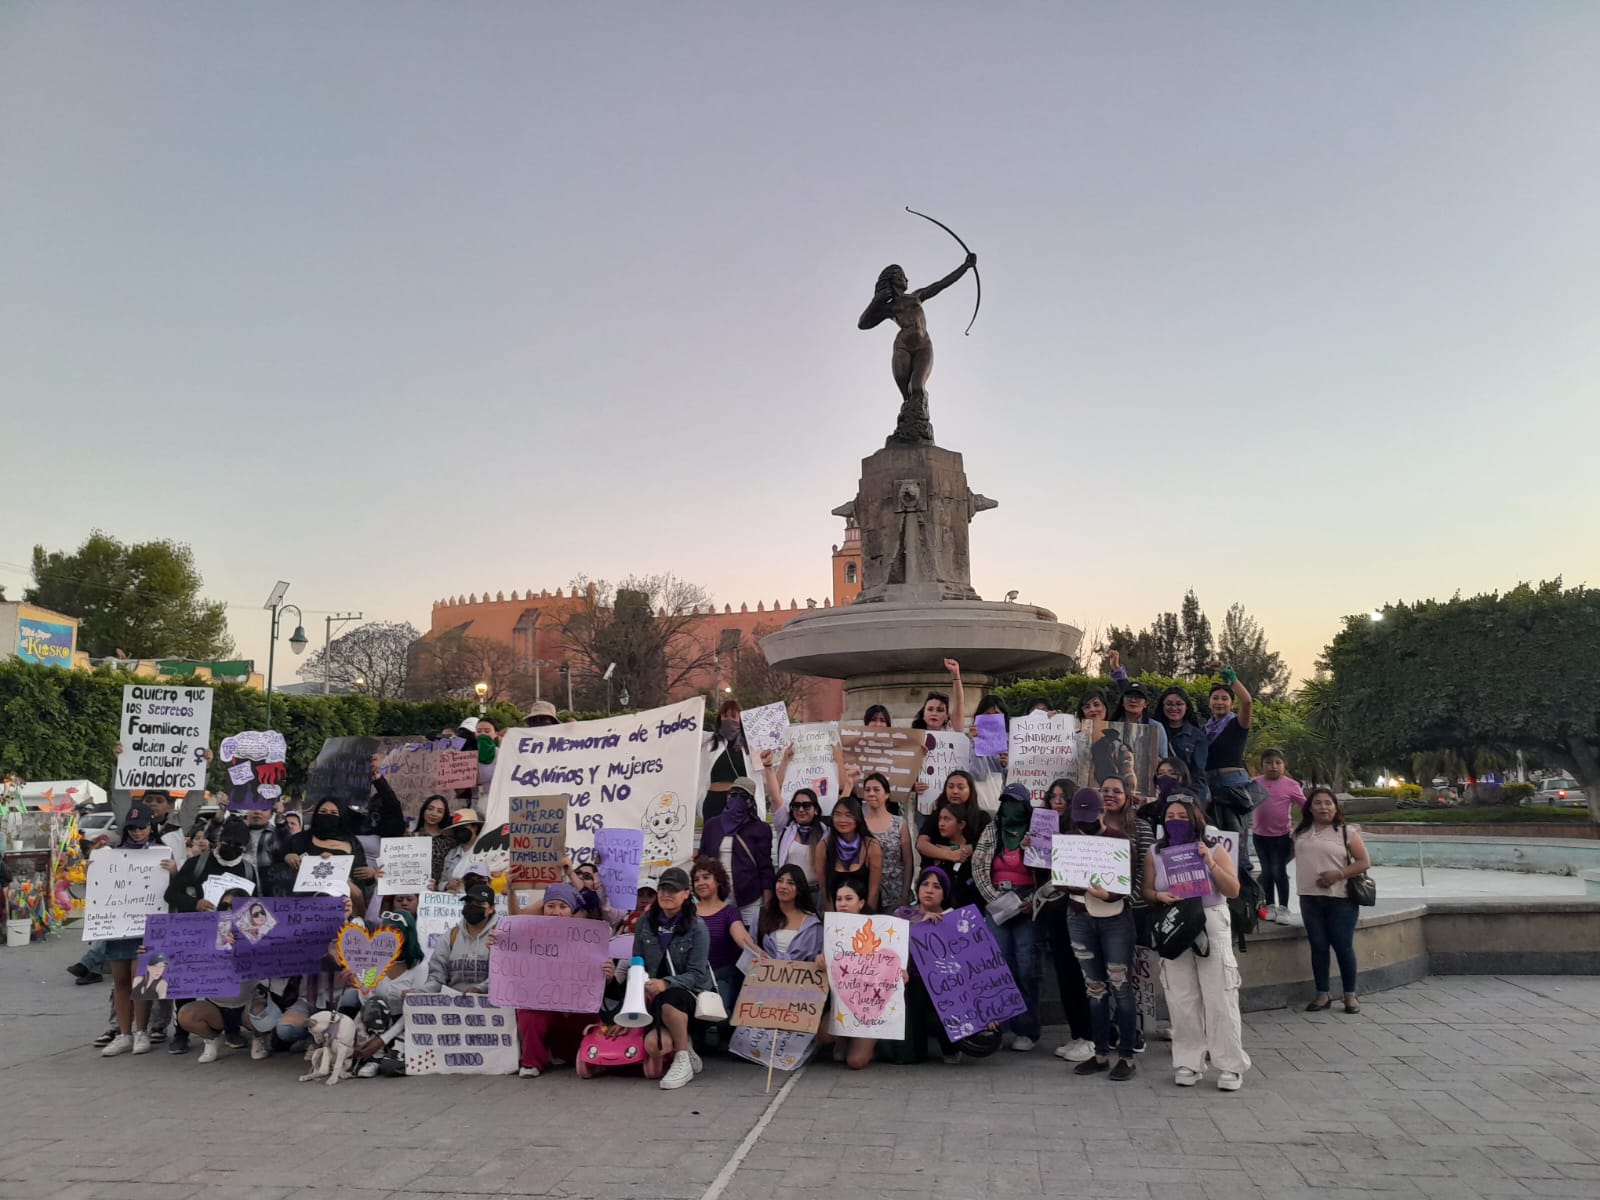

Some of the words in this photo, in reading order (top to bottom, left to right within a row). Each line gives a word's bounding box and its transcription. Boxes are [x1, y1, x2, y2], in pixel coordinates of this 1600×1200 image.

[184, 689, 206, 703] que
[126, 702, 142, 714] los
[128, 715, 200, 737] Familiares
[132, 737, 165, 753] dejen
[171, 740, 189, 755] de
[518, 738, 544, 754] En
[546, 729, 622, 755] Memoria
[628, 724, 649, 743] de
[138, 755, 185, 768] encubrir
[608, 756, 664, 780] Mujeres
[118, 768, 197, 788] Violadores
[569, 791, 591, 807] ue
[601, 784, 631, 803] NO
[511, 799, 523, 812] SI
[526, 799, 540, 809] MI
[525, 808, 565, 822] PERRO
[510, 823, 560, 834] ENTIENDE
[534, 837, 553, 849] TU
[510, 851, 558, 862] TAMBIEN
[910, 932, 948, 966] NO
[757, 964, 826, 986] JUNTAS
[927, 970, 965, 996] Caso
[739, 1002, 800, 1024] FUERTES
[789, 1002, 817, 1016] MAS
[411, 1033, 433, 1046] VOZ
[444, 1052, 484, 1067] MUNDO
